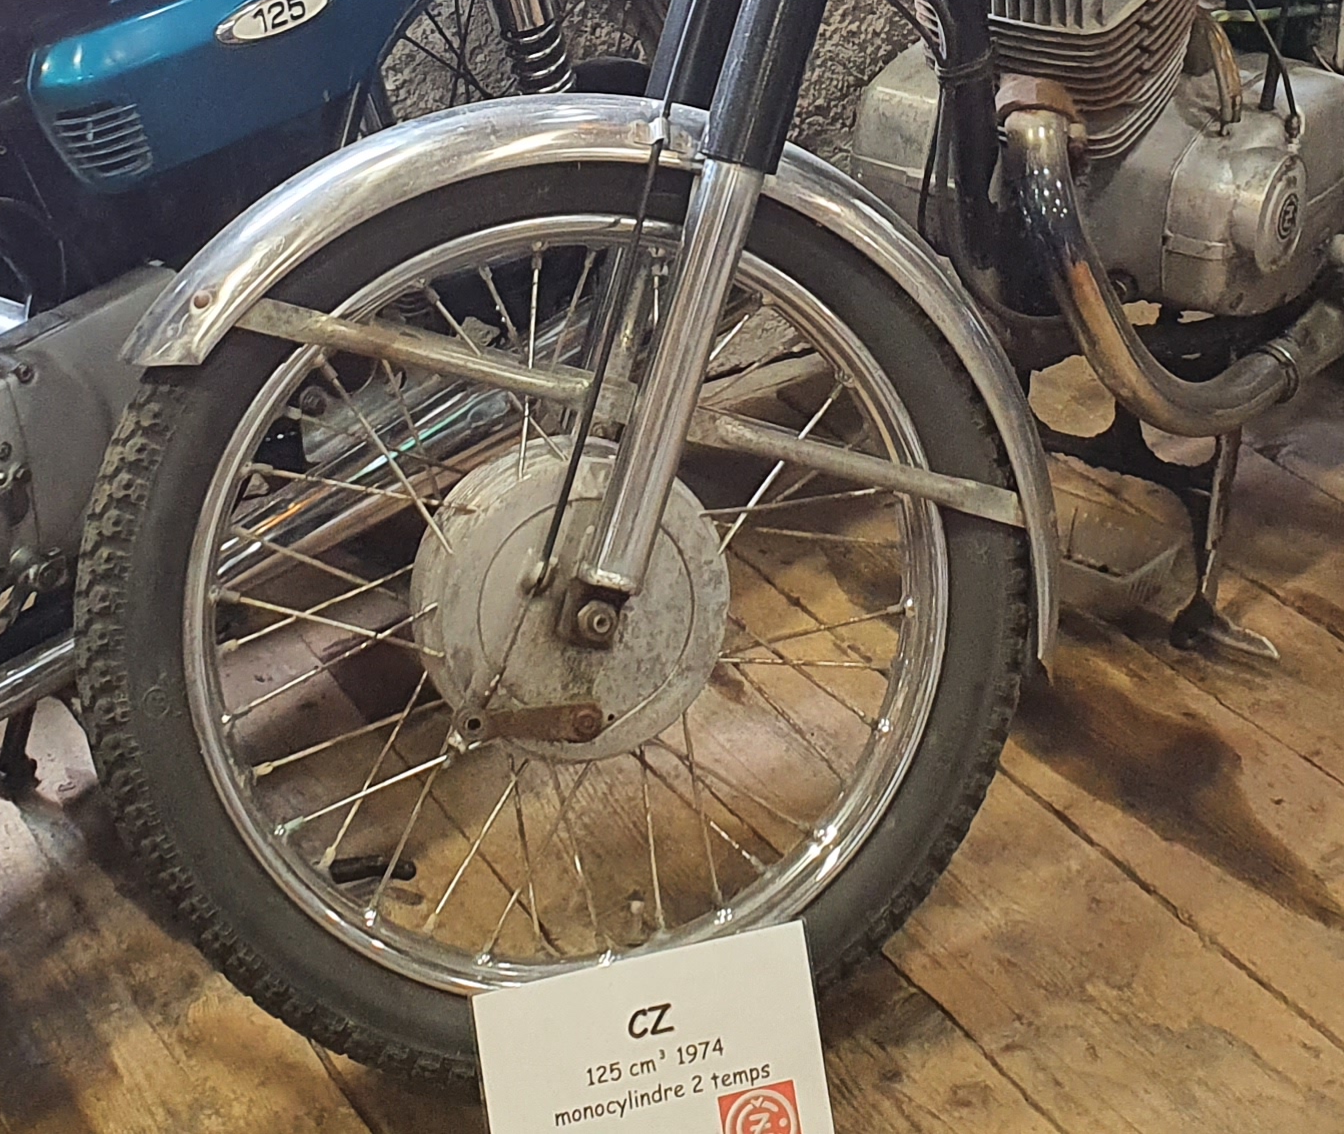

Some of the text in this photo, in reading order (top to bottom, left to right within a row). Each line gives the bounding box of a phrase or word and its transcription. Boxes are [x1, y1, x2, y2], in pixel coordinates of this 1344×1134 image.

[628, 1002, 675, 1039] CZ
[586, 1061, 623, 1087] 125
[676, 1037, 724, 1065] 1974
[554, 1064, 771, 1127] monocylindre 2 temps
